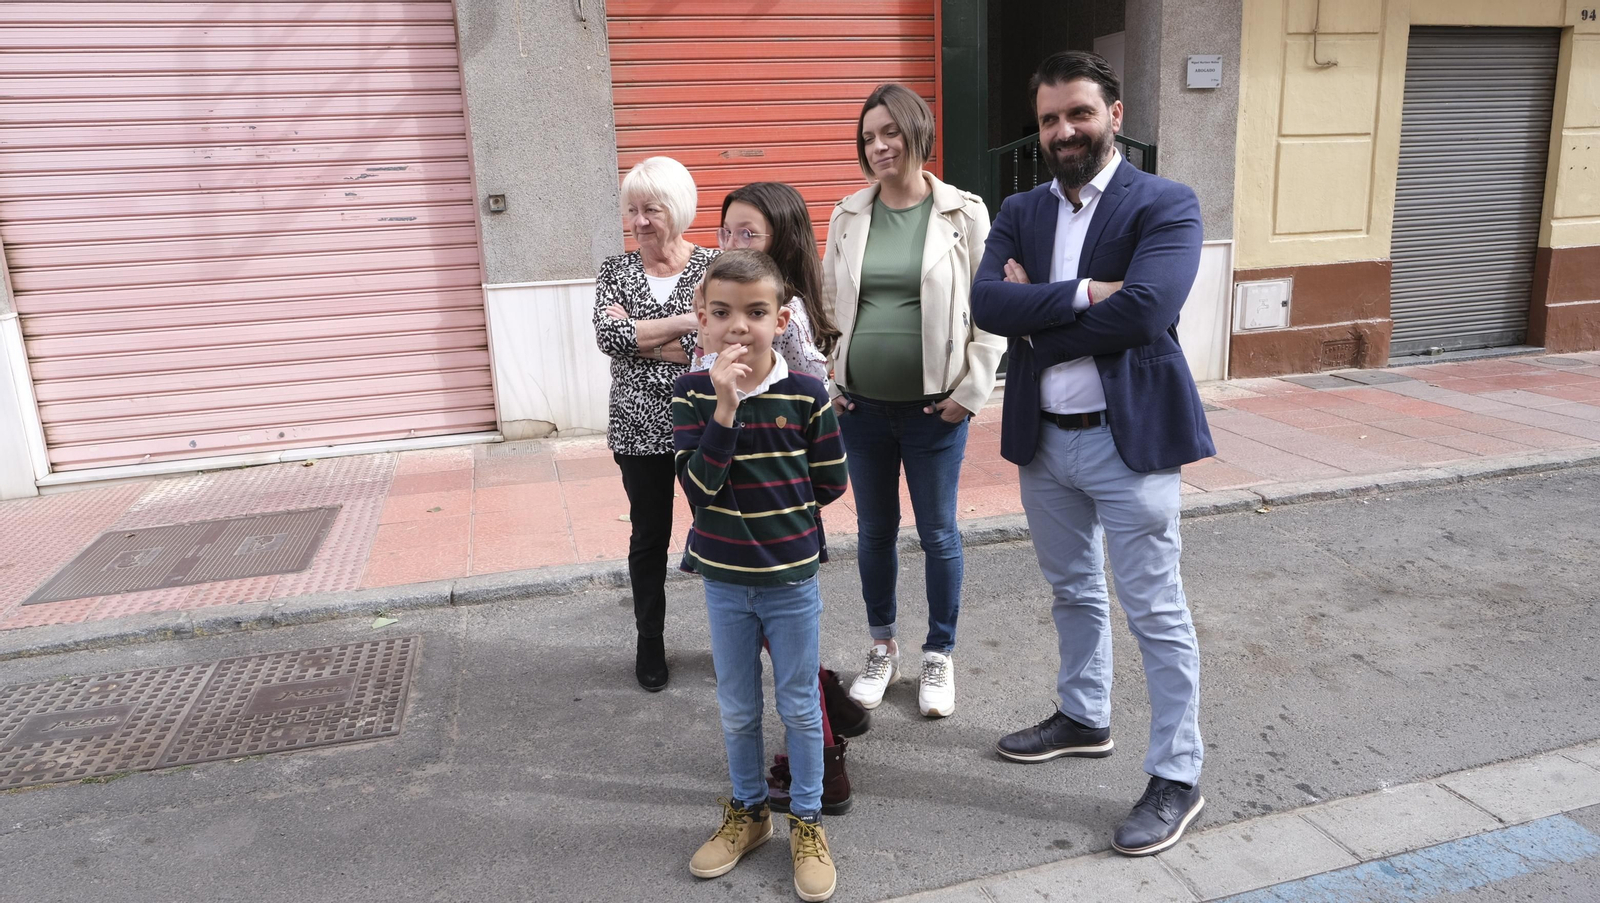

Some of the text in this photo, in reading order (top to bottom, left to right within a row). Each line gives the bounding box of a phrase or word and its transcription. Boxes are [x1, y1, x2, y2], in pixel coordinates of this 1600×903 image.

[1581, 9, 1596, 21] 94
[275, 686, 343, 701] JAZZTEL
[41, 716, 118, 731] JAZZTEL
